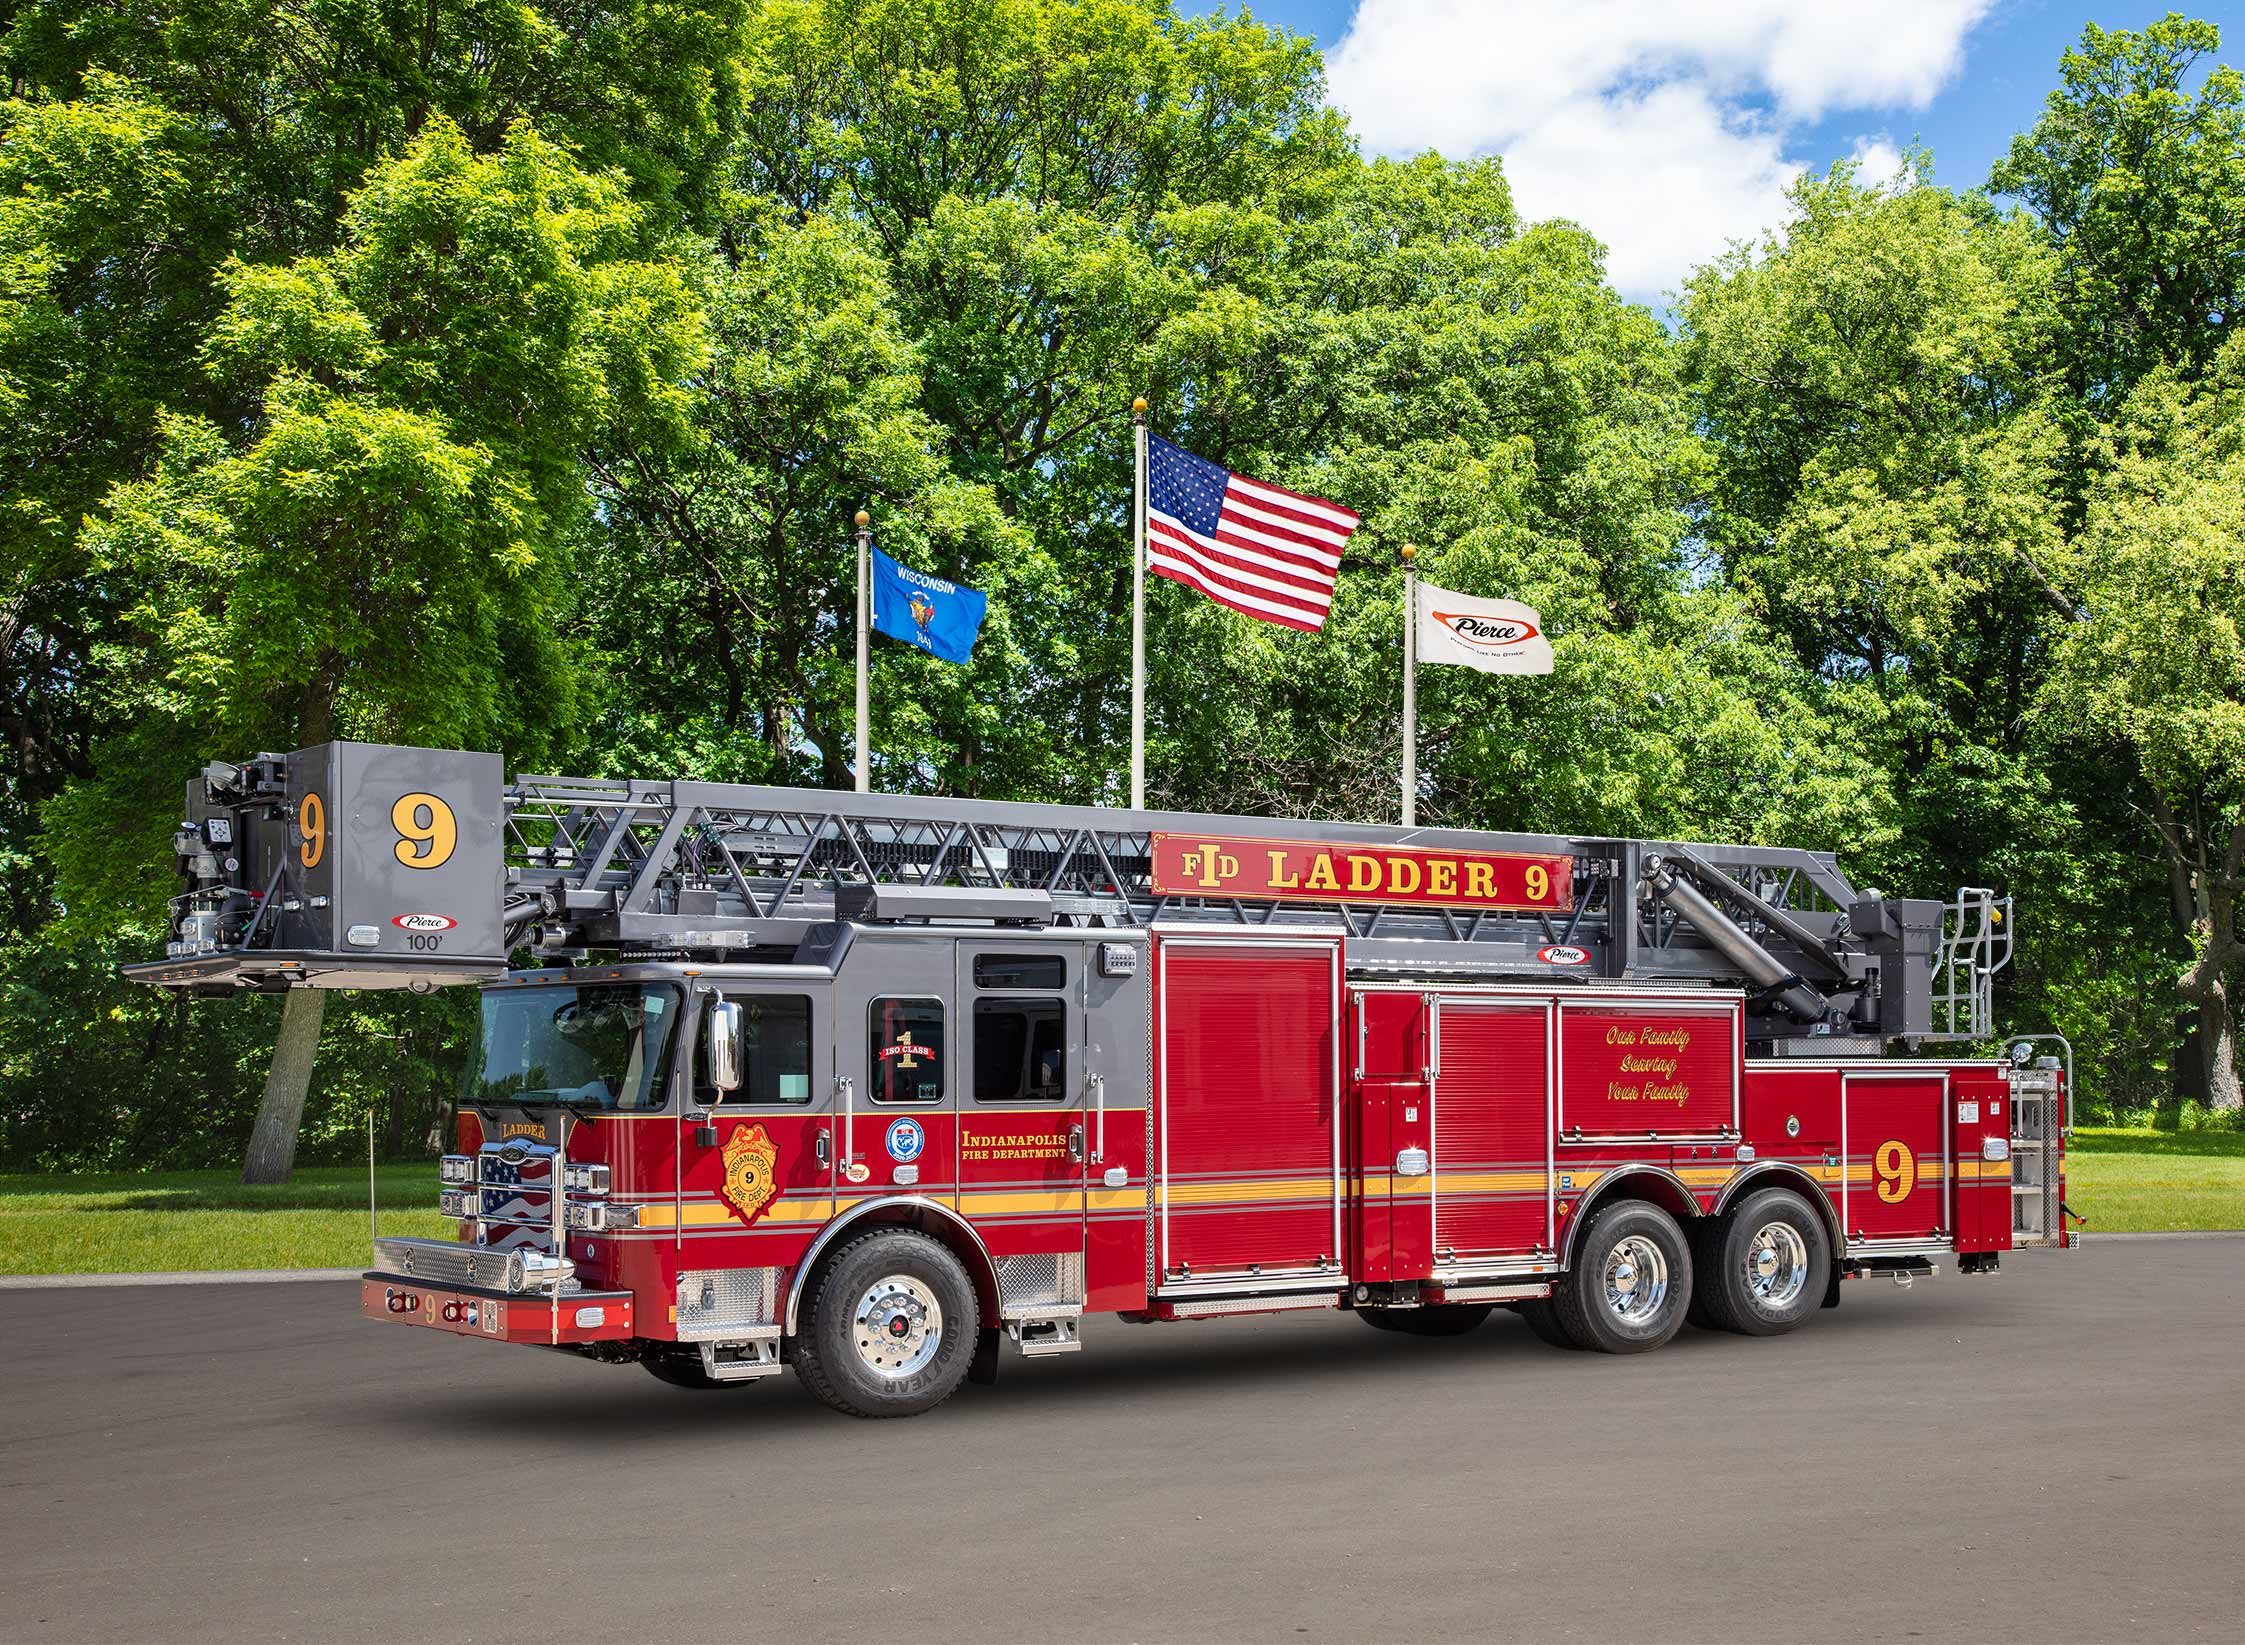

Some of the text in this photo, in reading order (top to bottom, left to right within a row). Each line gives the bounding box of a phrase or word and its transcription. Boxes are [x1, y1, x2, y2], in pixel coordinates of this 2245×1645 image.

[897, 566, 956, 595] WISCONSIN
[1455, 618, 1516, 638] Pierce
[300, 791, 325, 869] 9
[390, 791, 457, 870] 9
[1266, 850, 1498, 899] LADDER
[1524, 864, 1549, 901] 9
[406, 915, 442, 928] Pierce
[1550, 948, 1580, 961] Pierce
[885, 1046, 929, 1056] ISO CLASS
[896, 1030, 918, 1069] 1
[1606, 1025, 1691, 1053] Our Family
[1620, 1053, 1678, 1081] Serving
[1607, 1081, 1690, 1108] Your Family
[502, 1123, 546, 1140] LADDER
[729, 1154, 770, 1177] INDIANAPOLIS
[962, 1148, 1067, 1160] FIRE DEPARTMENT
[745, 1171, 754, 1185] 9
[1875, 1139, 1915, 1205] 9
[731, 1186, 768, 1202] FIRE DEPT.
[424, 1294, 437, 1325] 9
